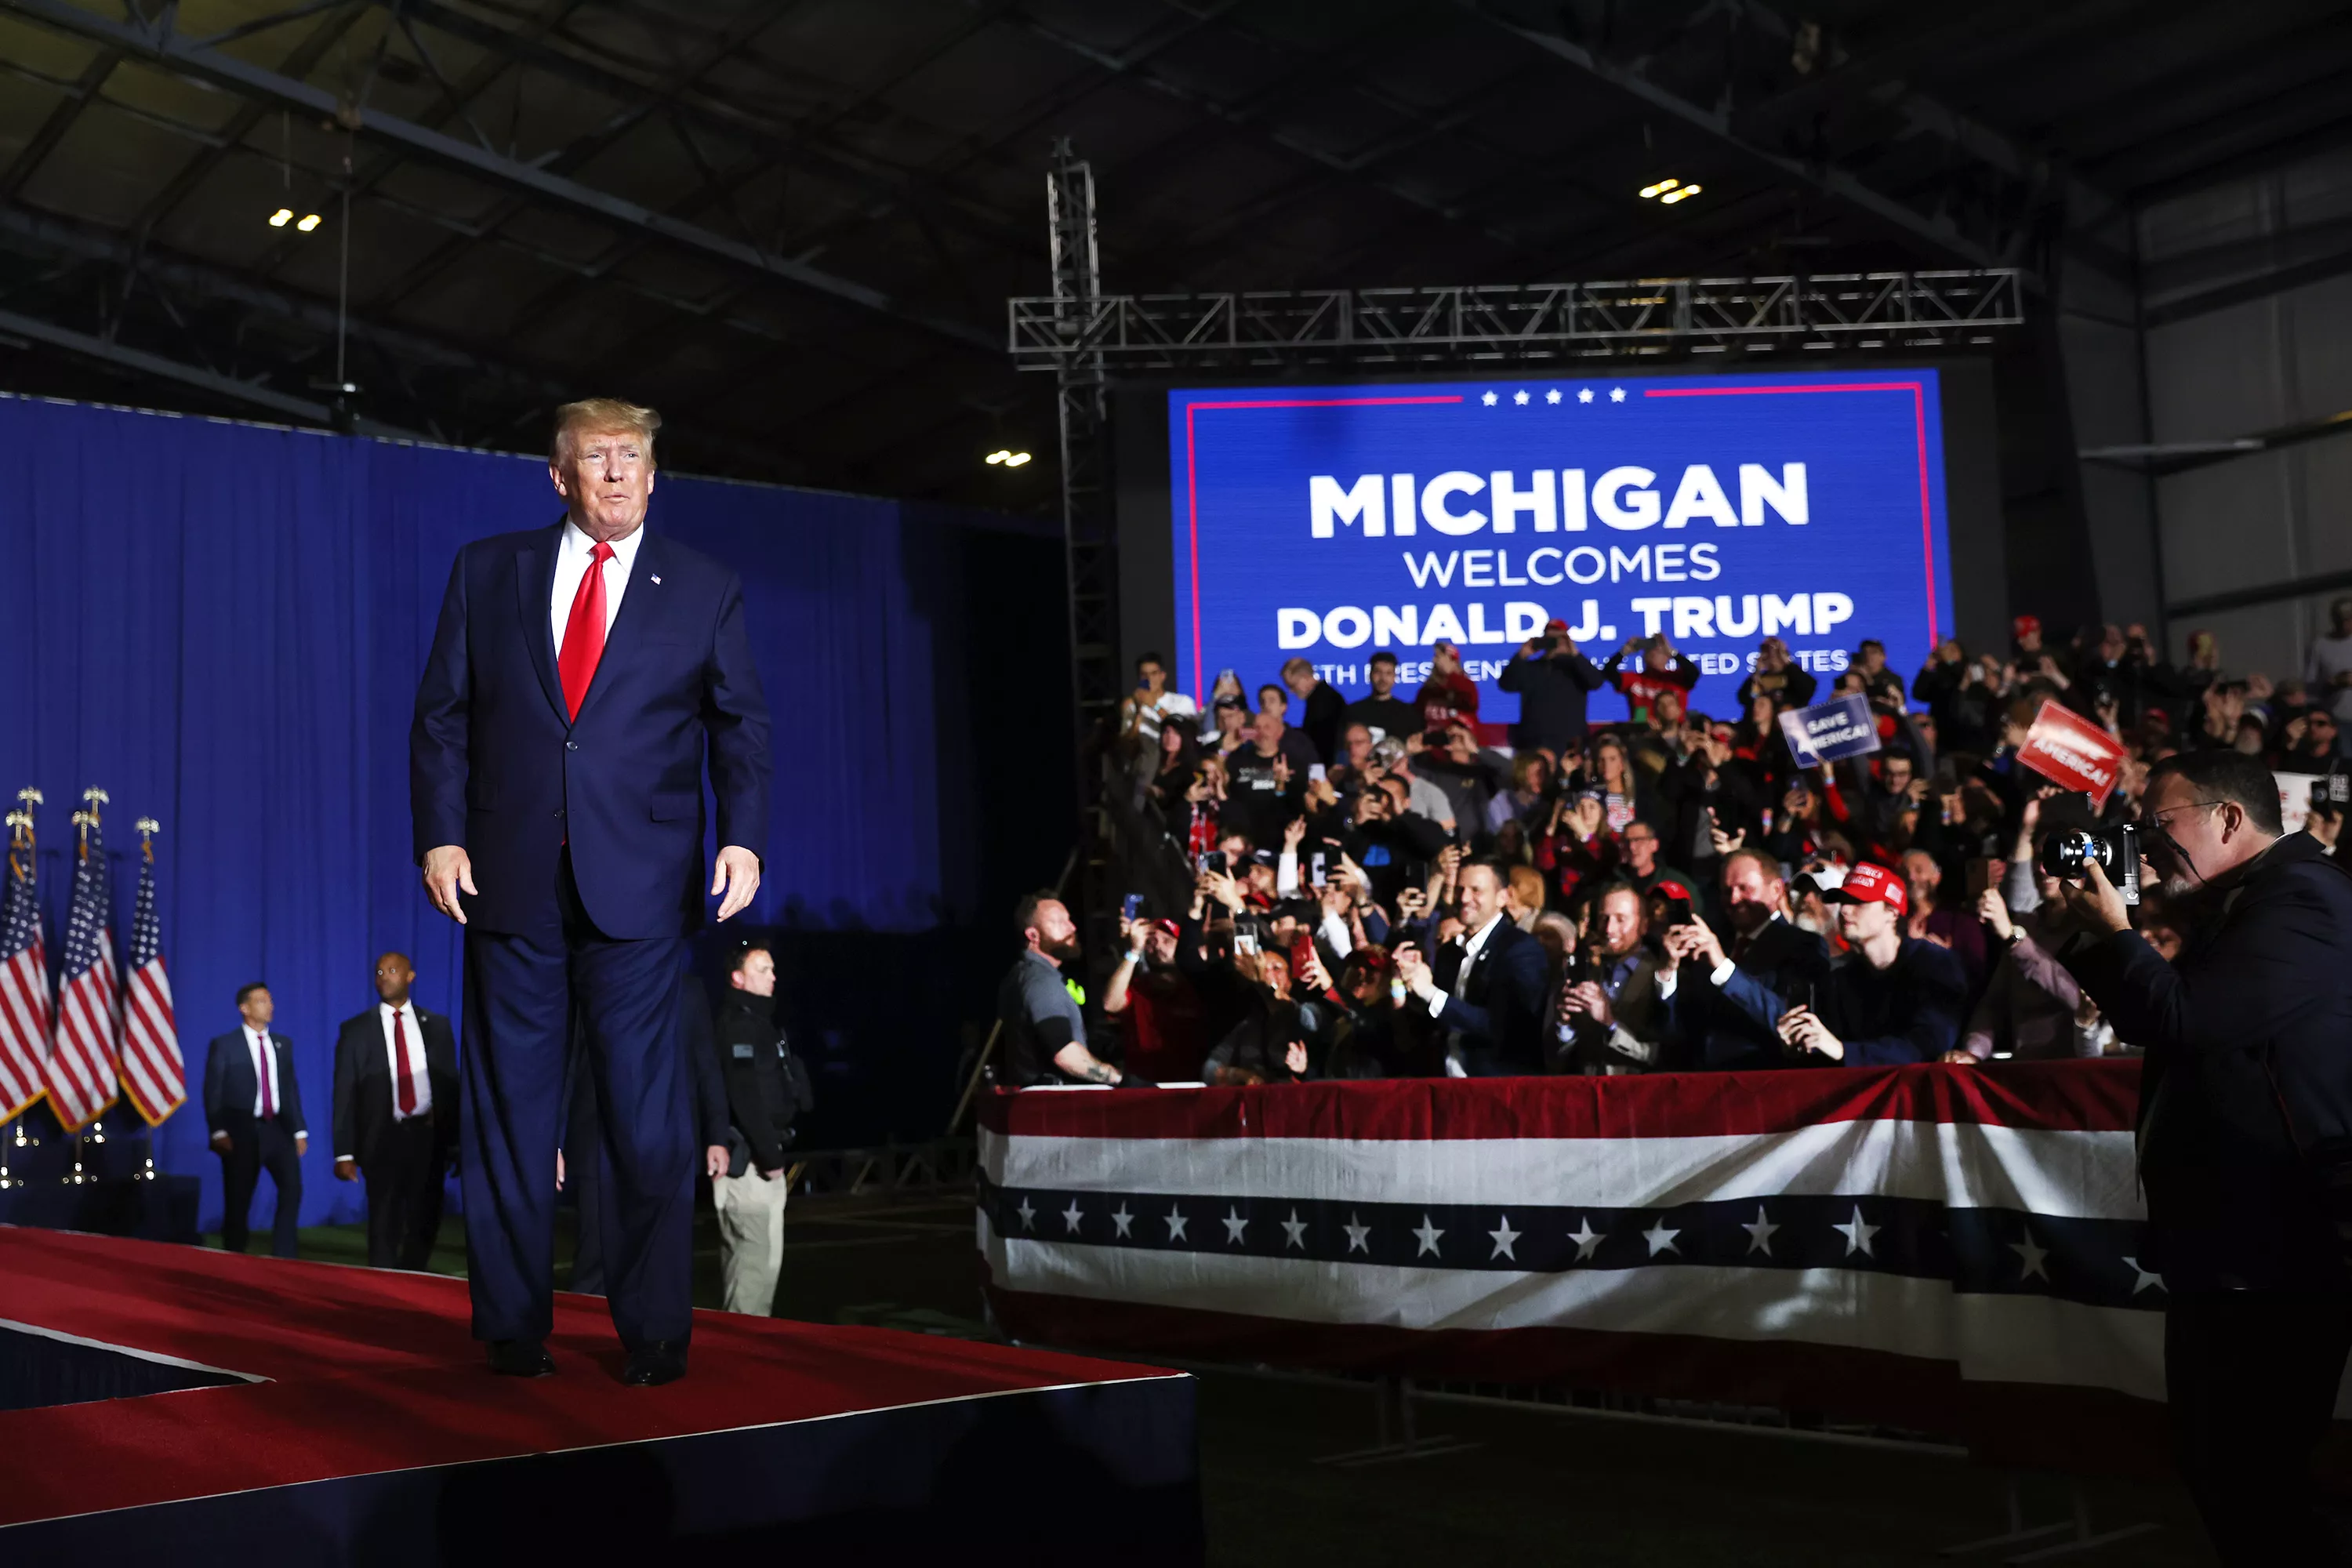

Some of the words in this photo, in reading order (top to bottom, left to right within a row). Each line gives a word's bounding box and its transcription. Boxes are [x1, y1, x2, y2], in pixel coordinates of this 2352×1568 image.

[1308, 462, 1809, 539] MICHIGAN
[1403, 543, 1721, 588] WELCOMES
[1277, 601, 1550, 649] DONALD
[1566, 598, 1617, 643] J.
[1631, 592, 1854, 641] TRUMP
[1806, 711, 1849, 735] SAVE
[2031, 737, 2111, 787] AMERICA!
